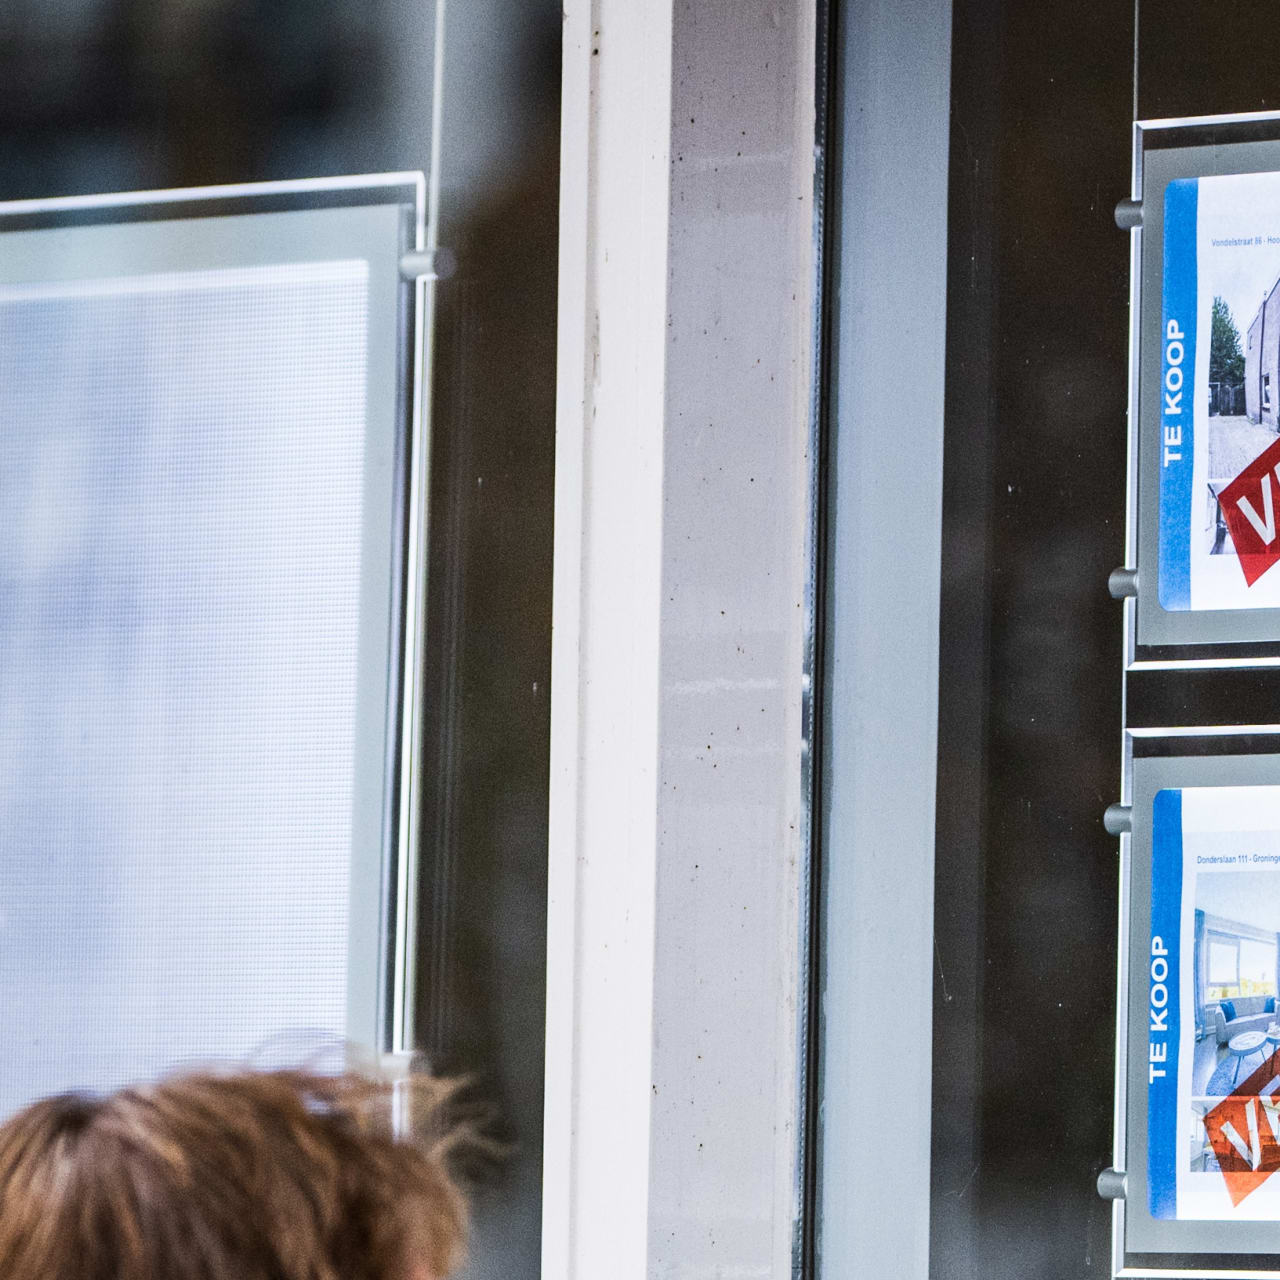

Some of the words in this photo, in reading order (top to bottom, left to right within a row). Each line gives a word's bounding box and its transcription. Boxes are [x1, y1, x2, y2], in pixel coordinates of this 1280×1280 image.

[1211, 237, 1253, 247] Vondelstraat
[1165, 319, 1185, 415] KOOP
[1164, 425, 1182, 467] TE
[1197, 855, 1237, 865] Donderslaan
[1149, 935, 1169, 1032] KOOP
[1148, 1041, 1168, 1085] TE
